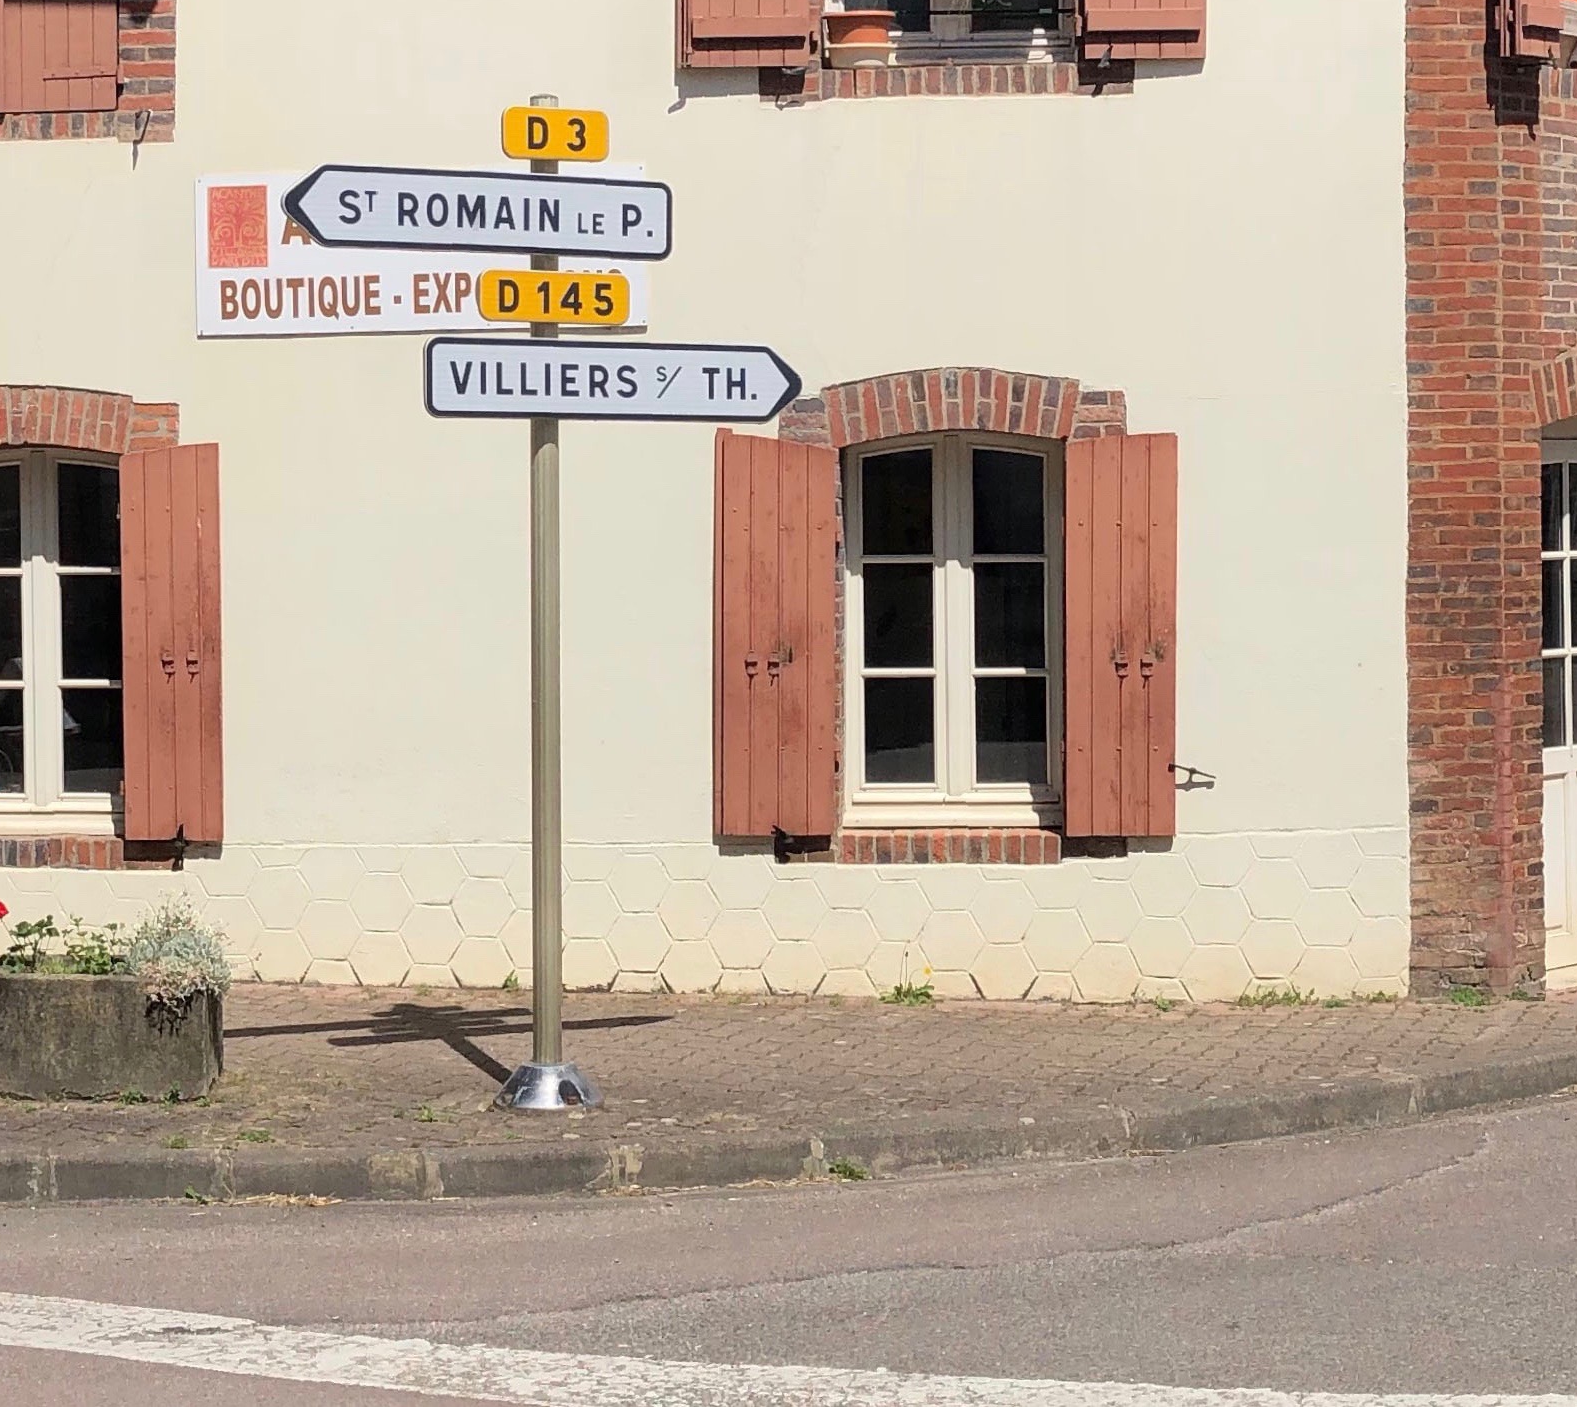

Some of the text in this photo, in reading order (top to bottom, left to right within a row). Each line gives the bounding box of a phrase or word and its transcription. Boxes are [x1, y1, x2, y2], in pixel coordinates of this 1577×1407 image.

[527, 116, 586, 151] D 3
[397, 192, 560, 233] ROMAIN
[577, 212, 605, 235] LE
[622, 203, 654, 237] P.
[220, 274, 382, 320] BOUTIQUE
[498, 279, 614, 316] D 145
[449, 361, 638, 399] VILLIERS
[702, 367, 758, 401] TH.
